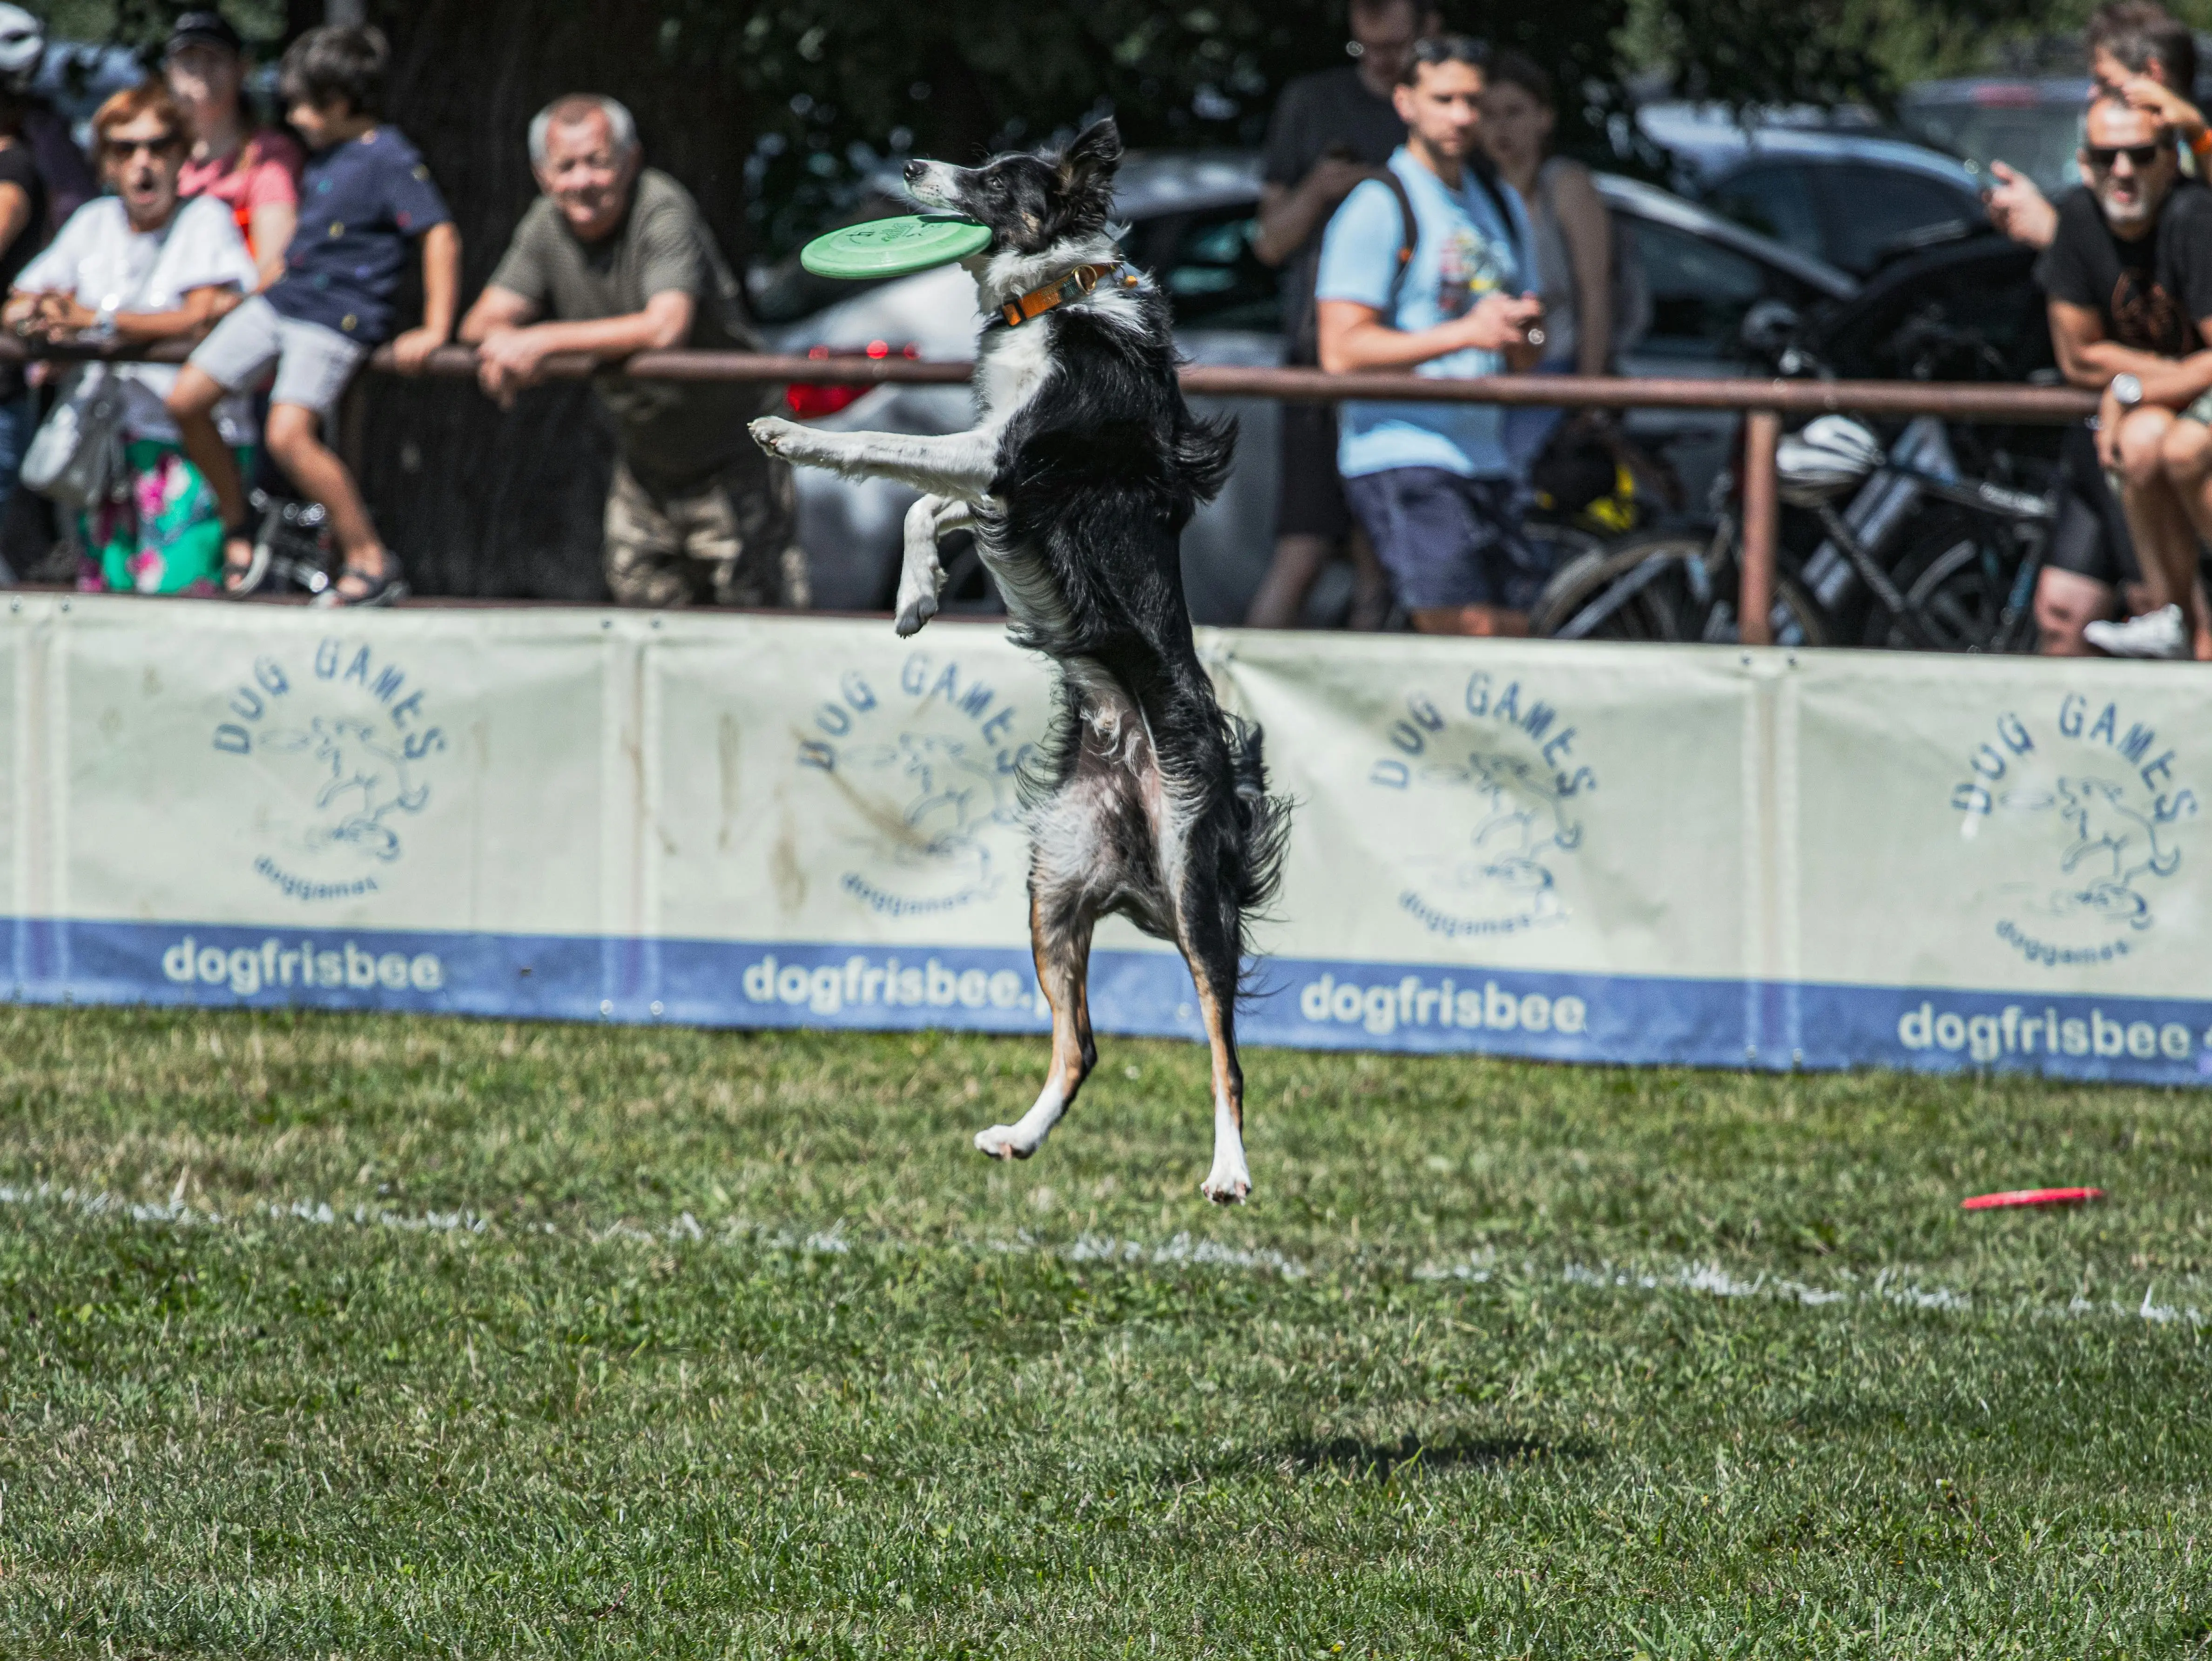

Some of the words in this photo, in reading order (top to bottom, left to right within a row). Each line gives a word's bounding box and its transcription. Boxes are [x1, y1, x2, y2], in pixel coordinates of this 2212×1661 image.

[314, 635, 445, 760] GAMES
[796, 670, 878, 772] DOG
[901, 651, 1032, 775] GAMES
[1369, 691, 1446, 790] DOG
[1465, 669, 1596, 796] GAMES
[2058, 692, 2198, 824] GAMES
[162, 936, 445, 995] dogfrisbee
[1301, 974, 1586, 1034] dogfrisbee
[1898, 1000, 2191, 1062] dogfrisbee
